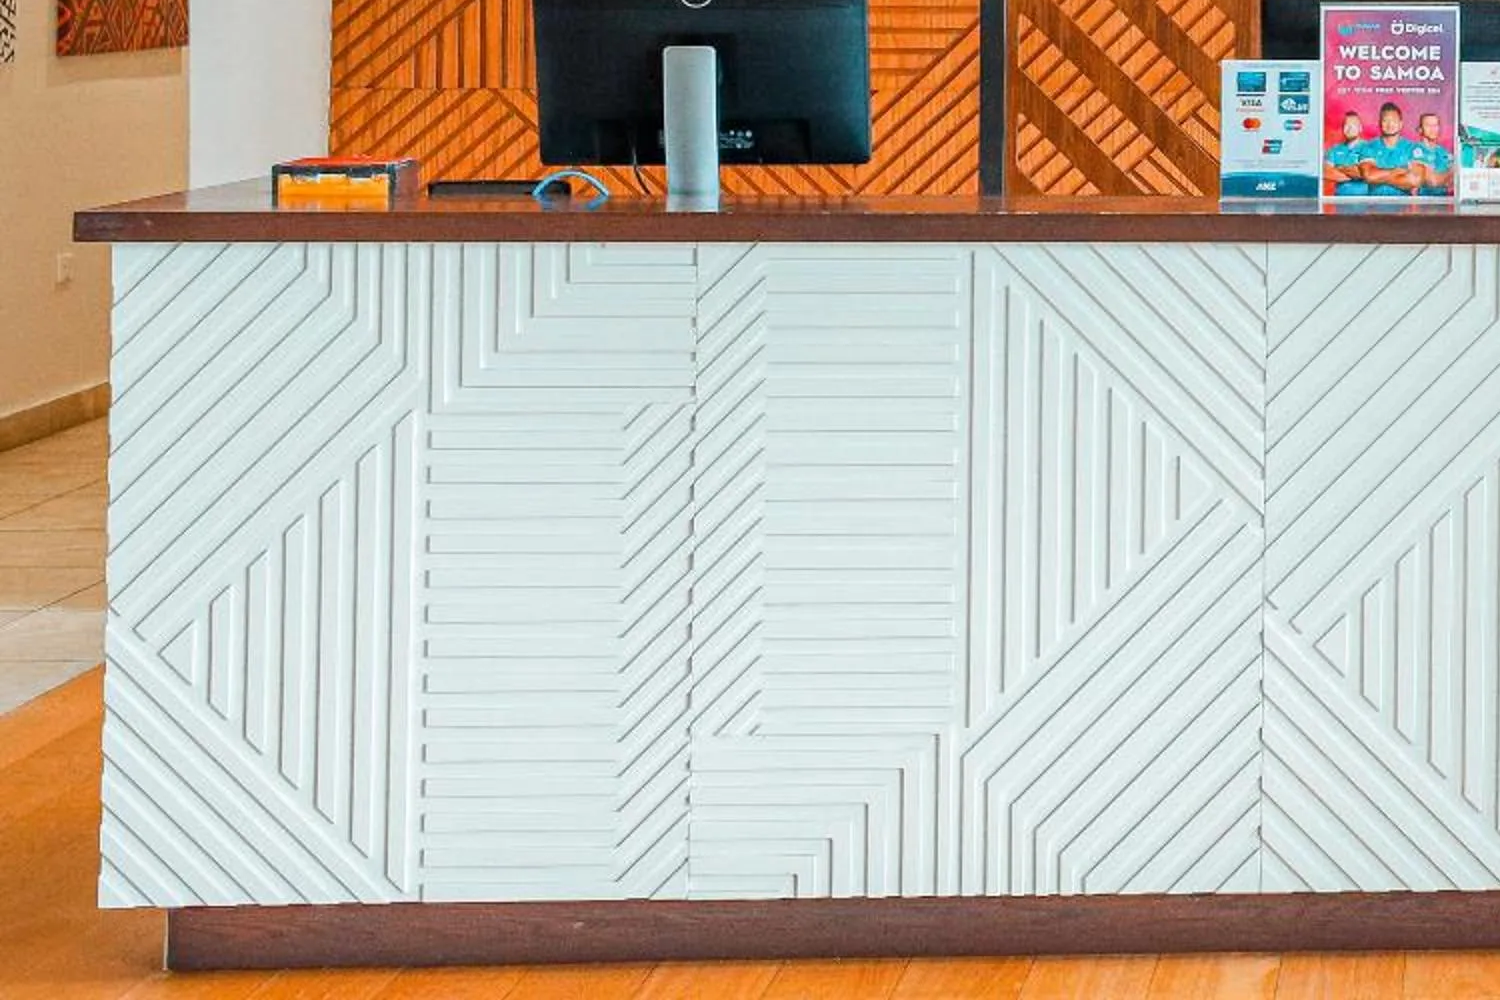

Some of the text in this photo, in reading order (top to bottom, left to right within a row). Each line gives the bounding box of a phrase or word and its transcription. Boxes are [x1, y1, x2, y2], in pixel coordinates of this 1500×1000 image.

[1405, 23, 1443, 36] Digicel
[1339, 45, 1441, 60] WELCOME
[1333, 65, 1445, 81] TO SAMOA
